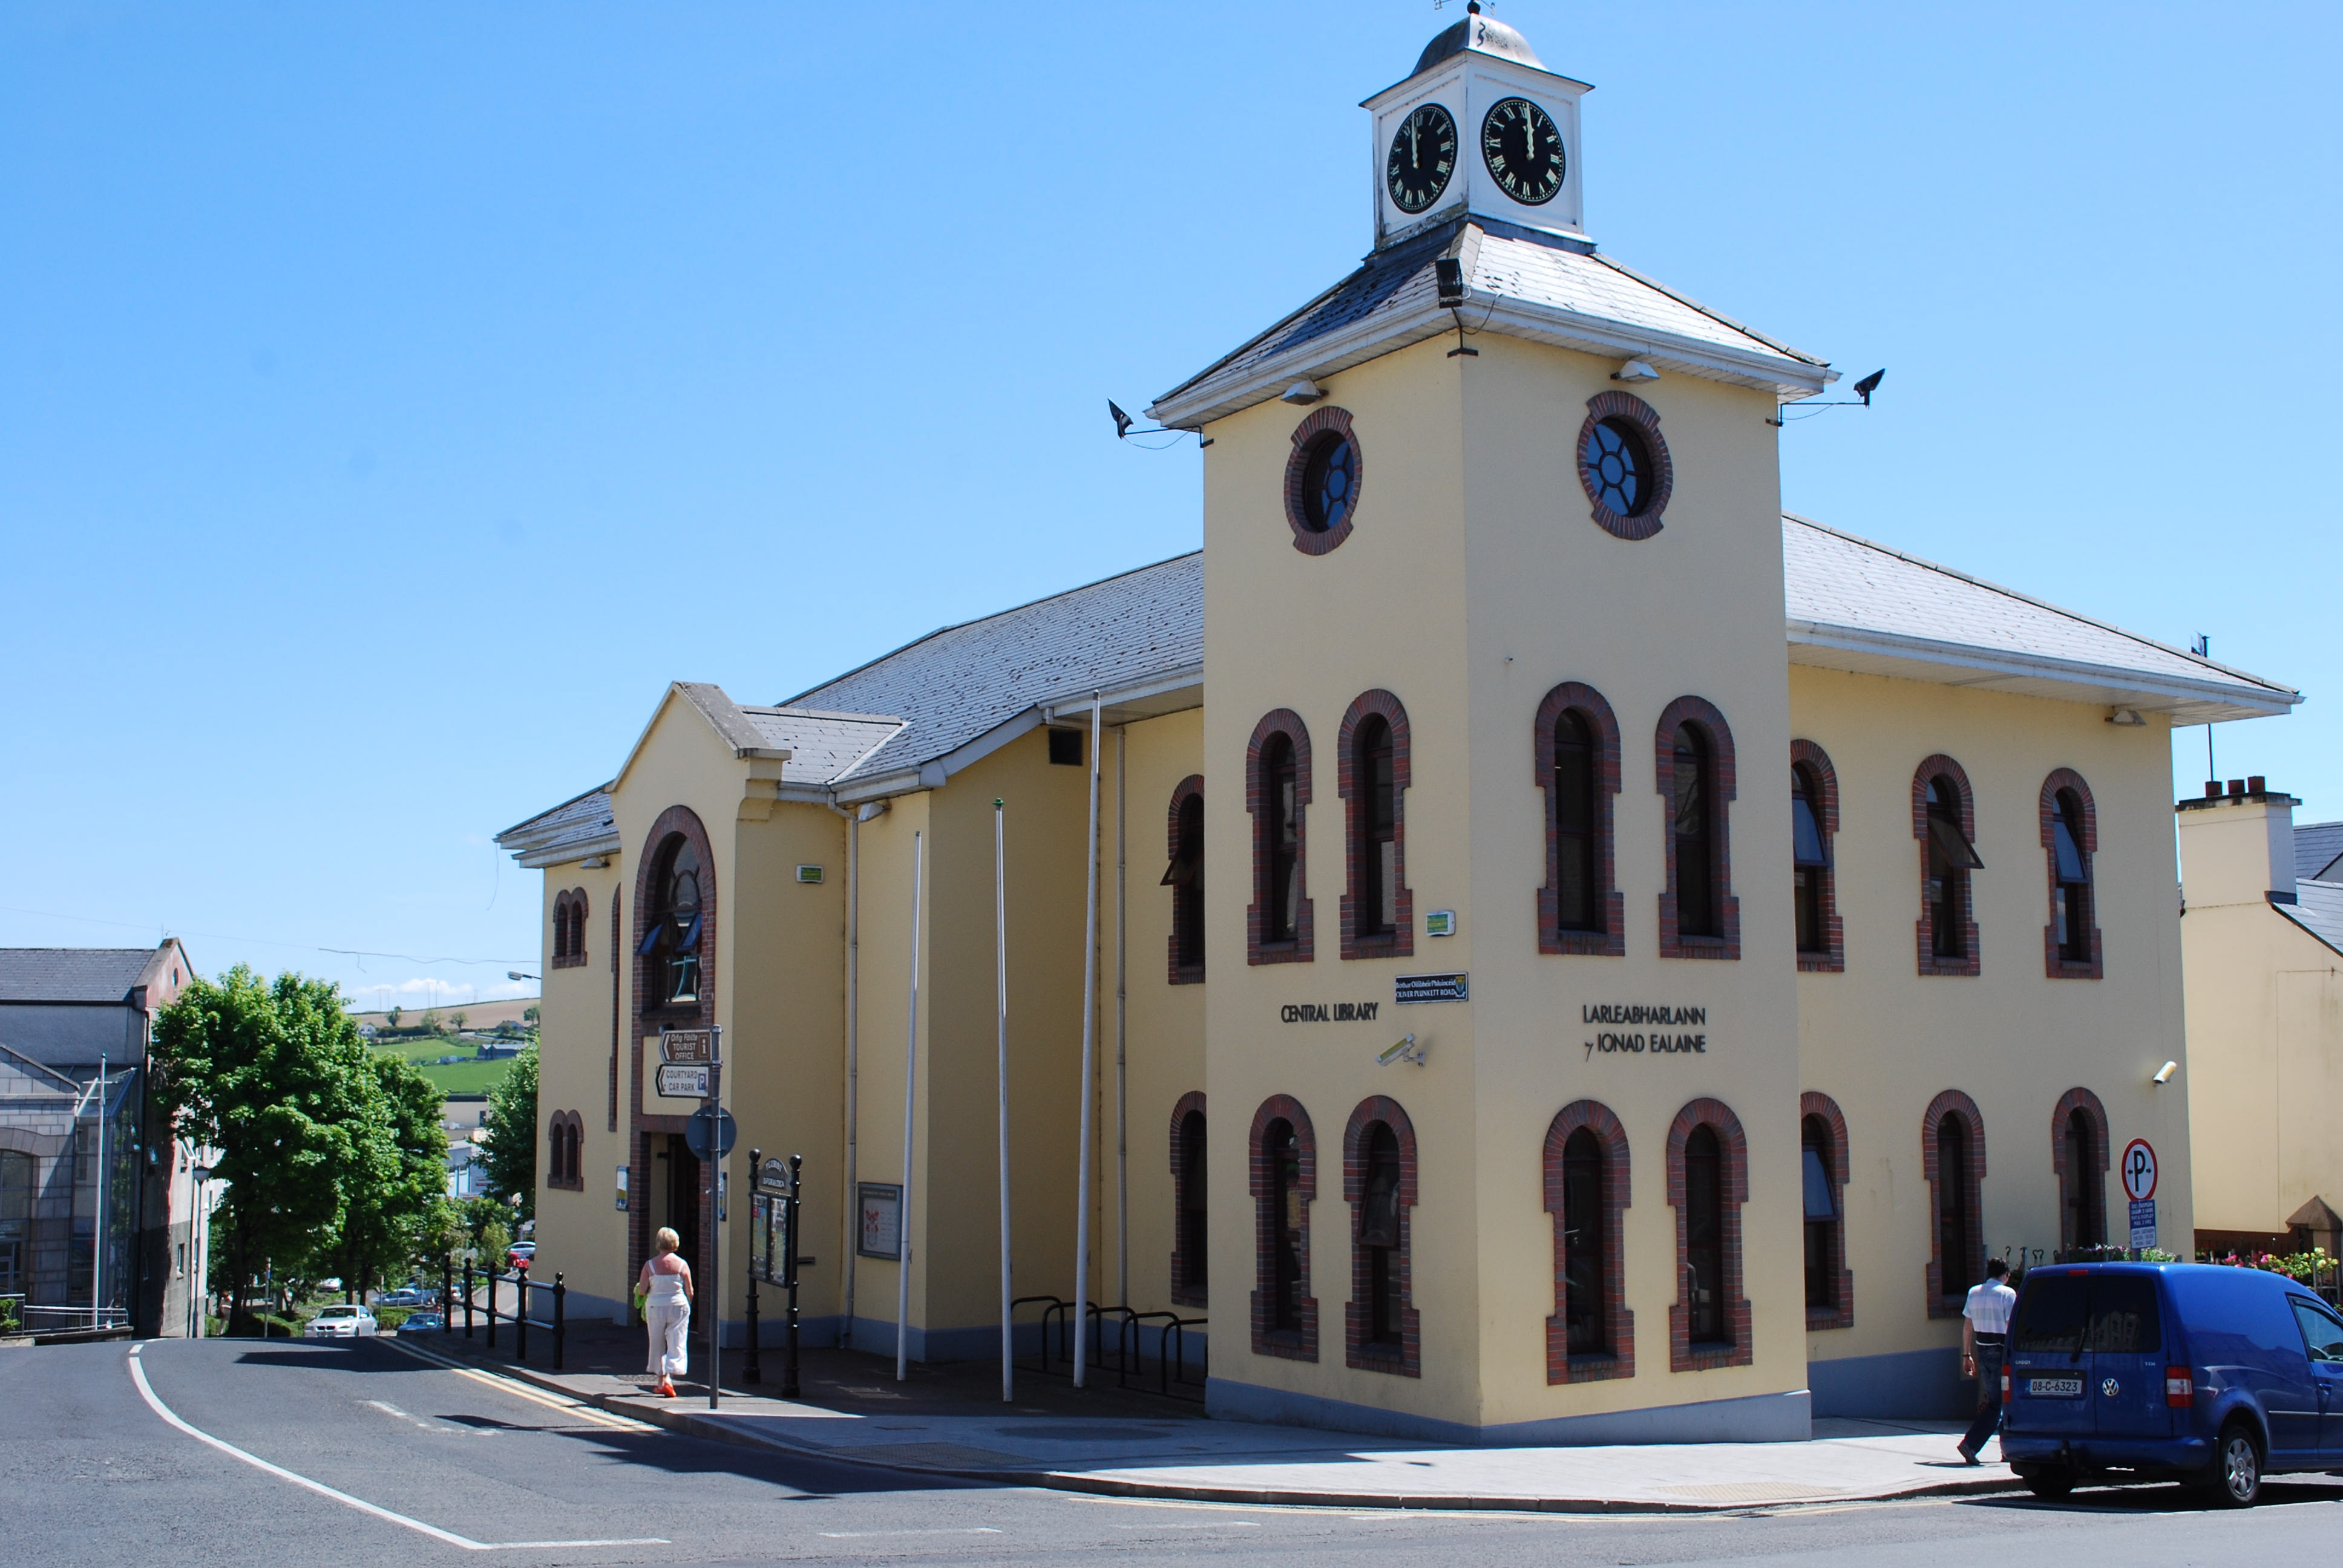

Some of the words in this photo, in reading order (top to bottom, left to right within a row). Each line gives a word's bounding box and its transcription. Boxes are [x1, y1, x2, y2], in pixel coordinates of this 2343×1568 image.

[1280, 1004, 1330, 1023] CENTRAL
[1334, 1002, 1378, 1021] LIBRARY
[673, 1042, 696, 1051] TOURIST
[1598, 1033, 1645, 1053] IONAD
[1650, 1034, 1706, 1053] EALAINE
[666, 1070, 698, 1079] COURTYARD
[669, 1082, 680, 1091] CAR
[681, 1083, 695, 1091] PARK
[699, 1075, 705, 1088] P
[2134, 1150, 2146, 1192] P
[2032, 1381, 2078, 1391] 08-C-6323
